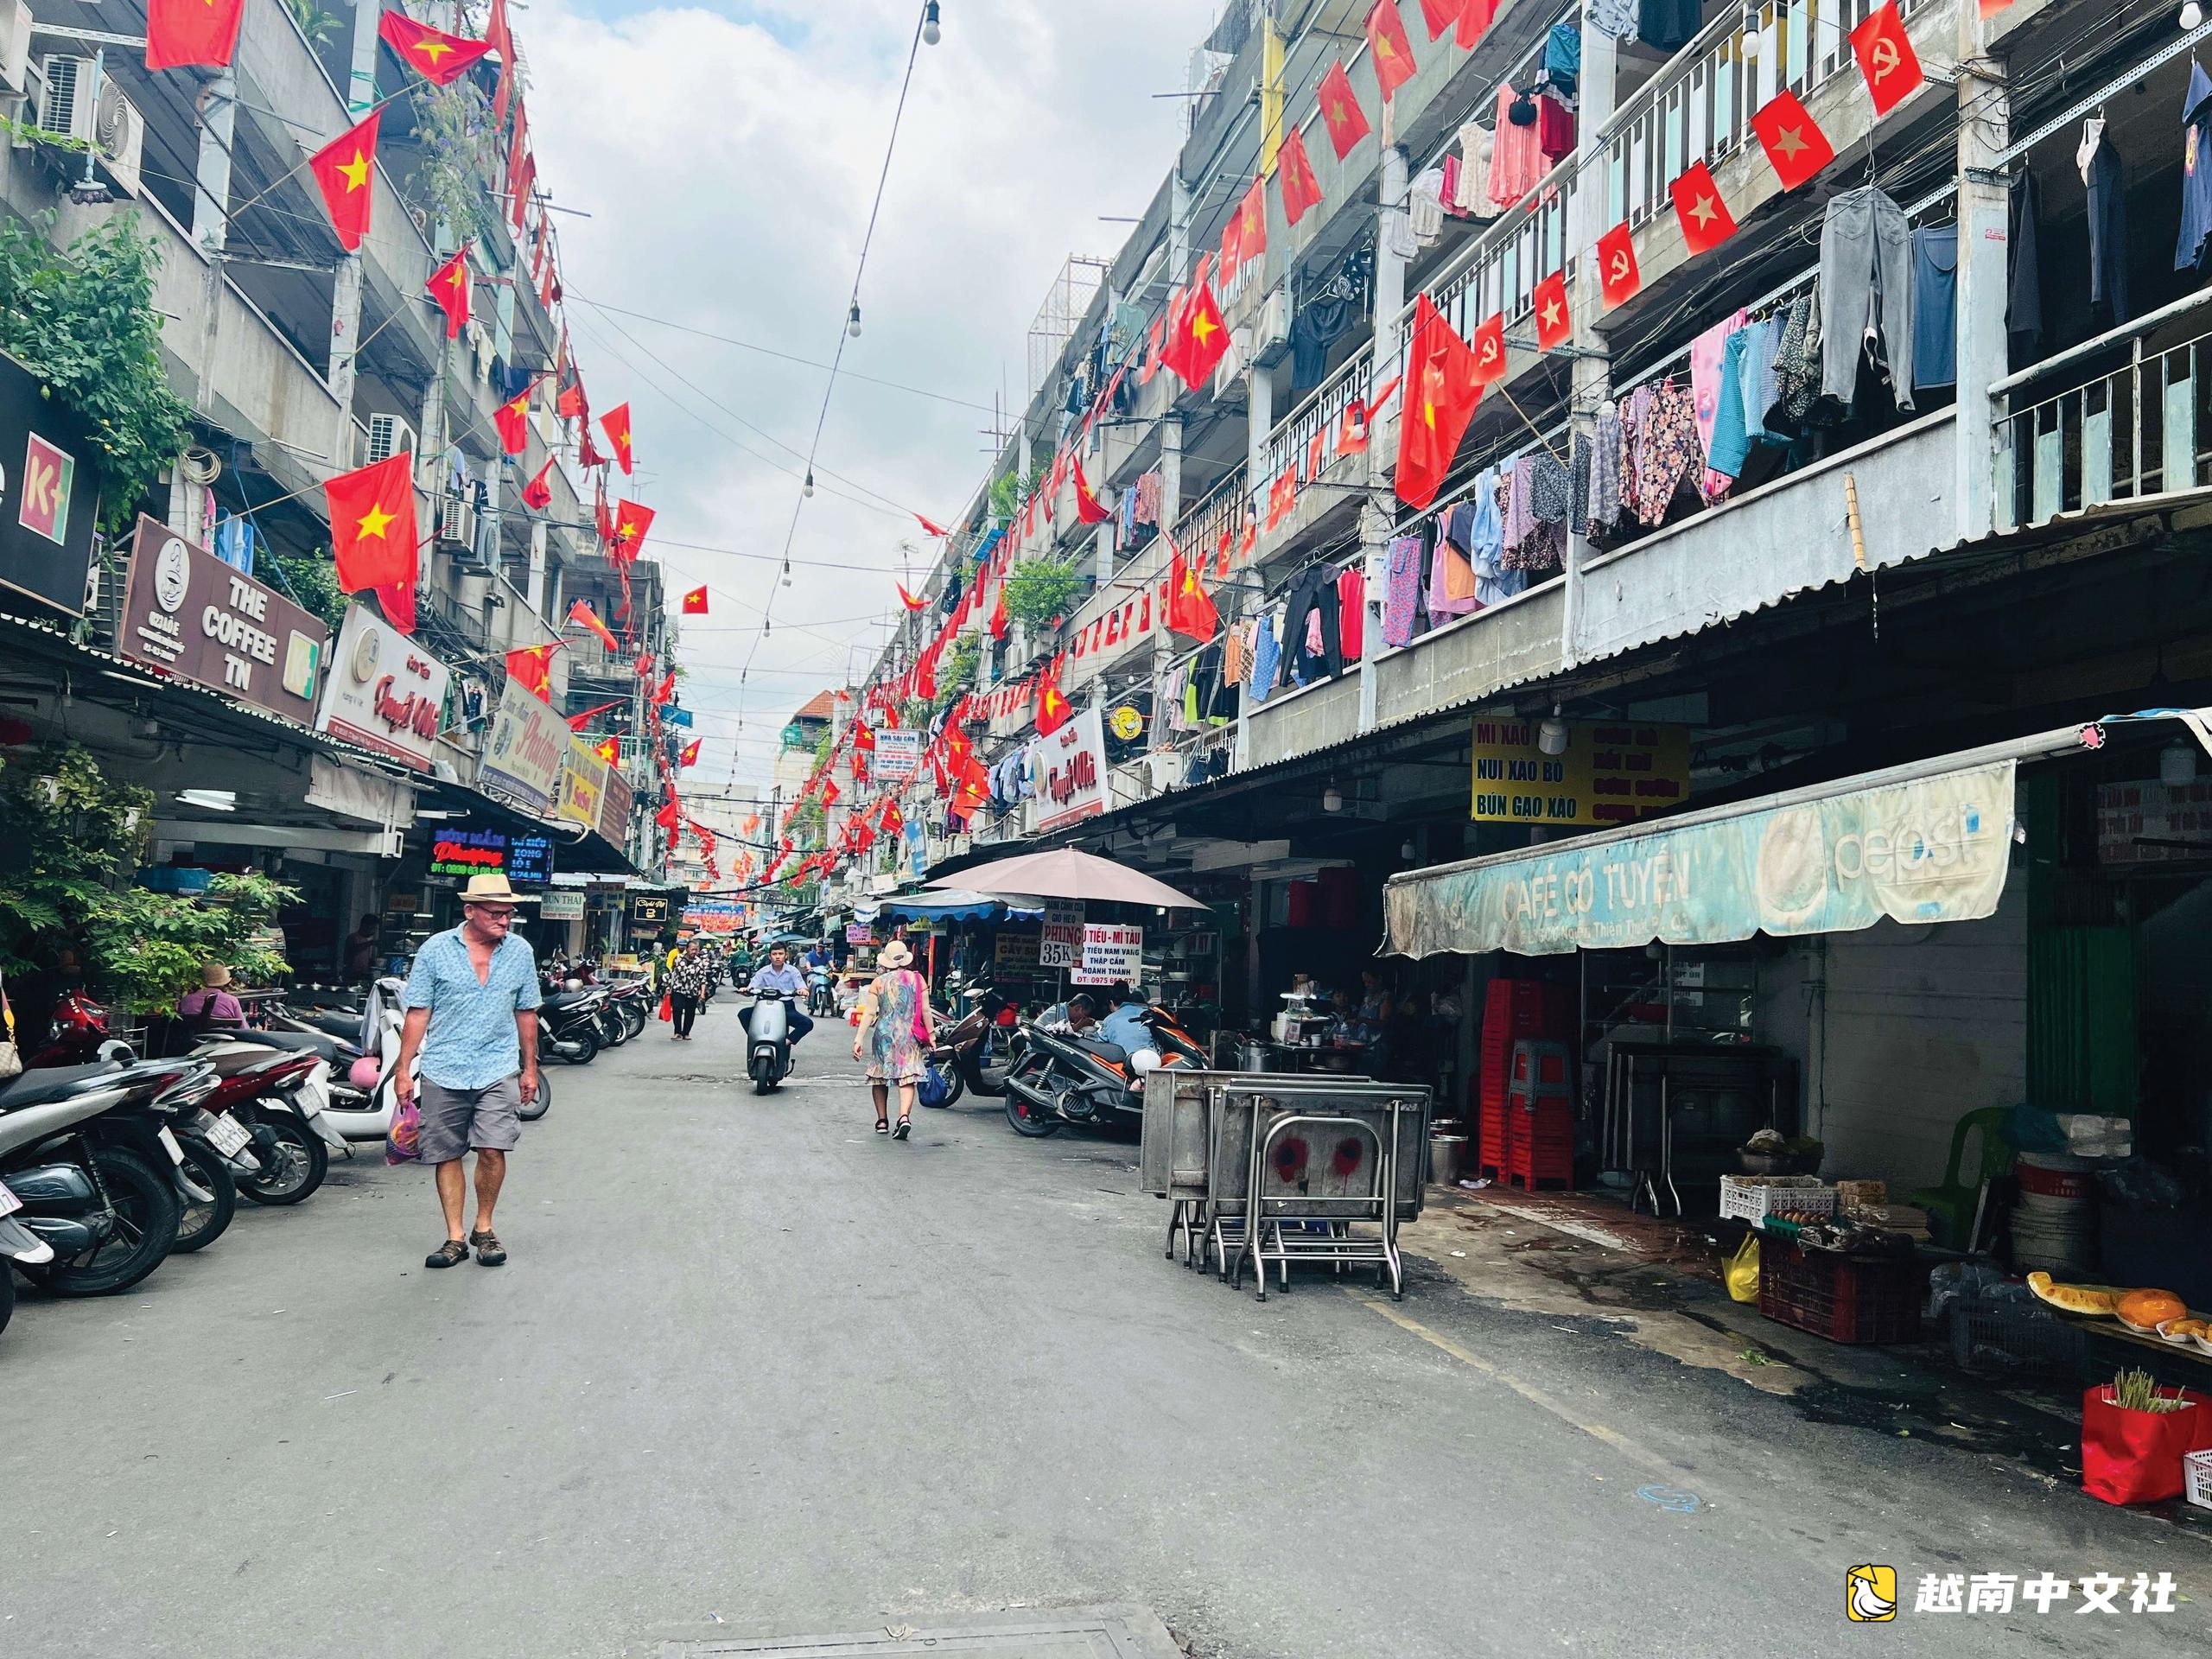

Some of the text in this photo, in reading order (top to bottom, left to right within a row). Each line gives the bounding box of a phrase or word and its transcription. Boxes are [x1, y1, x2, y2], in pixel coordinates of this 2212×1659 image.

[27, 455, 65, 516] K+
[229, 575, 269, 623] THE
[201, 605, 277, 665] COFFEE
[224, 652, 252, 691] TN
[1477, 759, 1503, 779] NUI
[1507, 757, 1538, 782] XÀO
[1542, 759, 1564, 783] BÒ
[1477, 791, 1507, 815] BÚN
[1547, 794, 1577, 819] XÀO
[1835, 802, 1973, 893] pepsi
[1501, 862, 1558, 923] CAFÉ
[1565, 856, 1594, 915] CÔ
[1603, 843, 1690, 910] TUYẾN
[1043, 944, 1071, 964] 35K
[1090, 926, 1107, 944] TIẾU
[1113, 929, 1123, 944] MÌ
[1125, 929, 1140, 945] TÀU
[1090, 957, 1108, 966] THẬP
